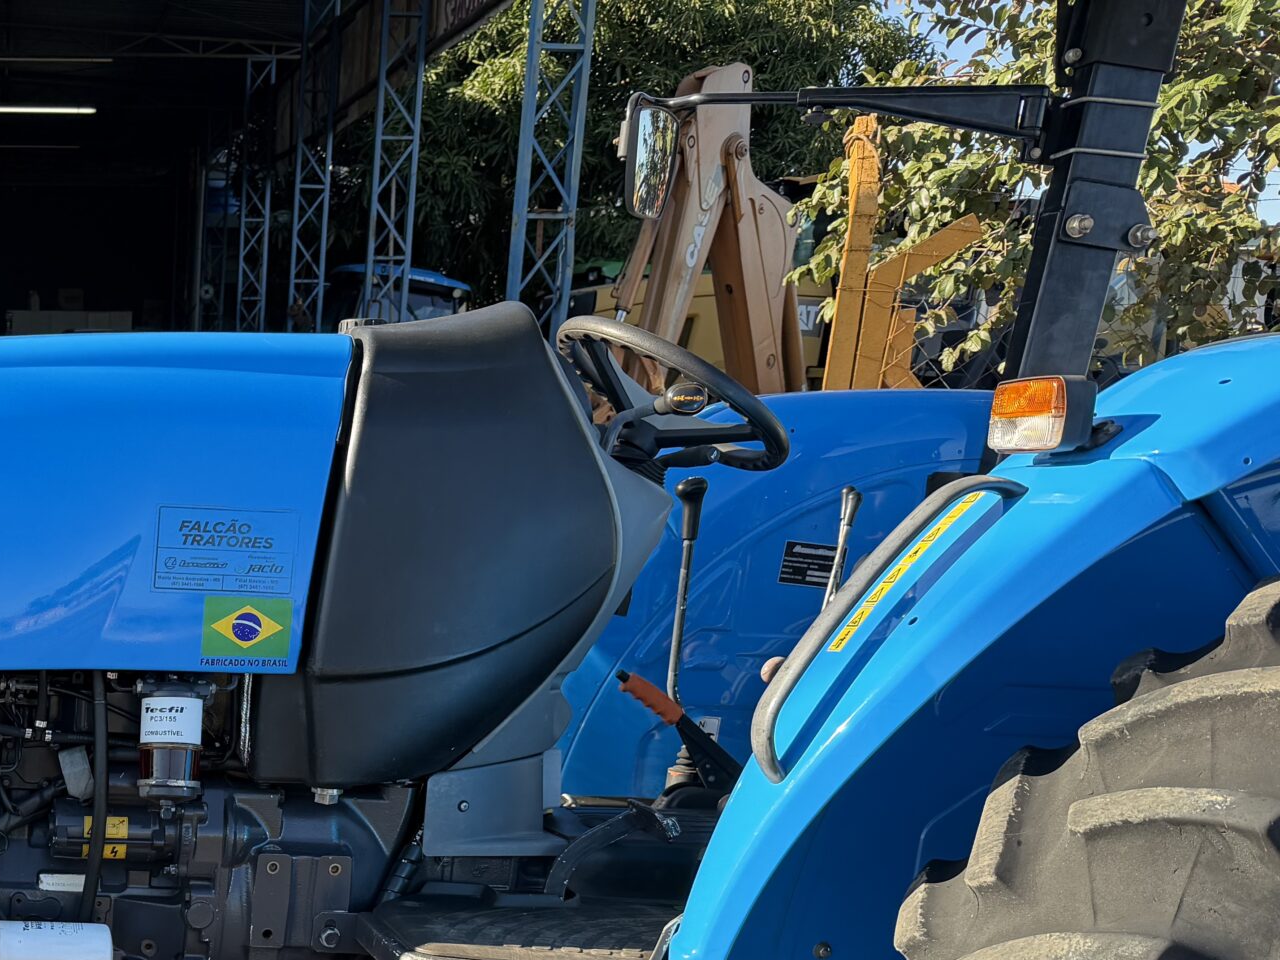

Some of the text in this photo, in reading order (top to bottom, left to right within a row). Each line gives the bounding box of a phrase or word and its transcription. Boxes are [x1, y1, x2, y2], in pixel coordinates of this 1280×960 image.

[798, 304, 819, 331] AT
[178, 518, 252, 535] FALCÃO
[181, 533, 274, 549] TRATORES
[200, 657, 288, 668] FABRICADO NO BRASIL
[144, 706, 185, 714] Tecfil
[144, 729, 184, 737] COMBUSTÍVEL
